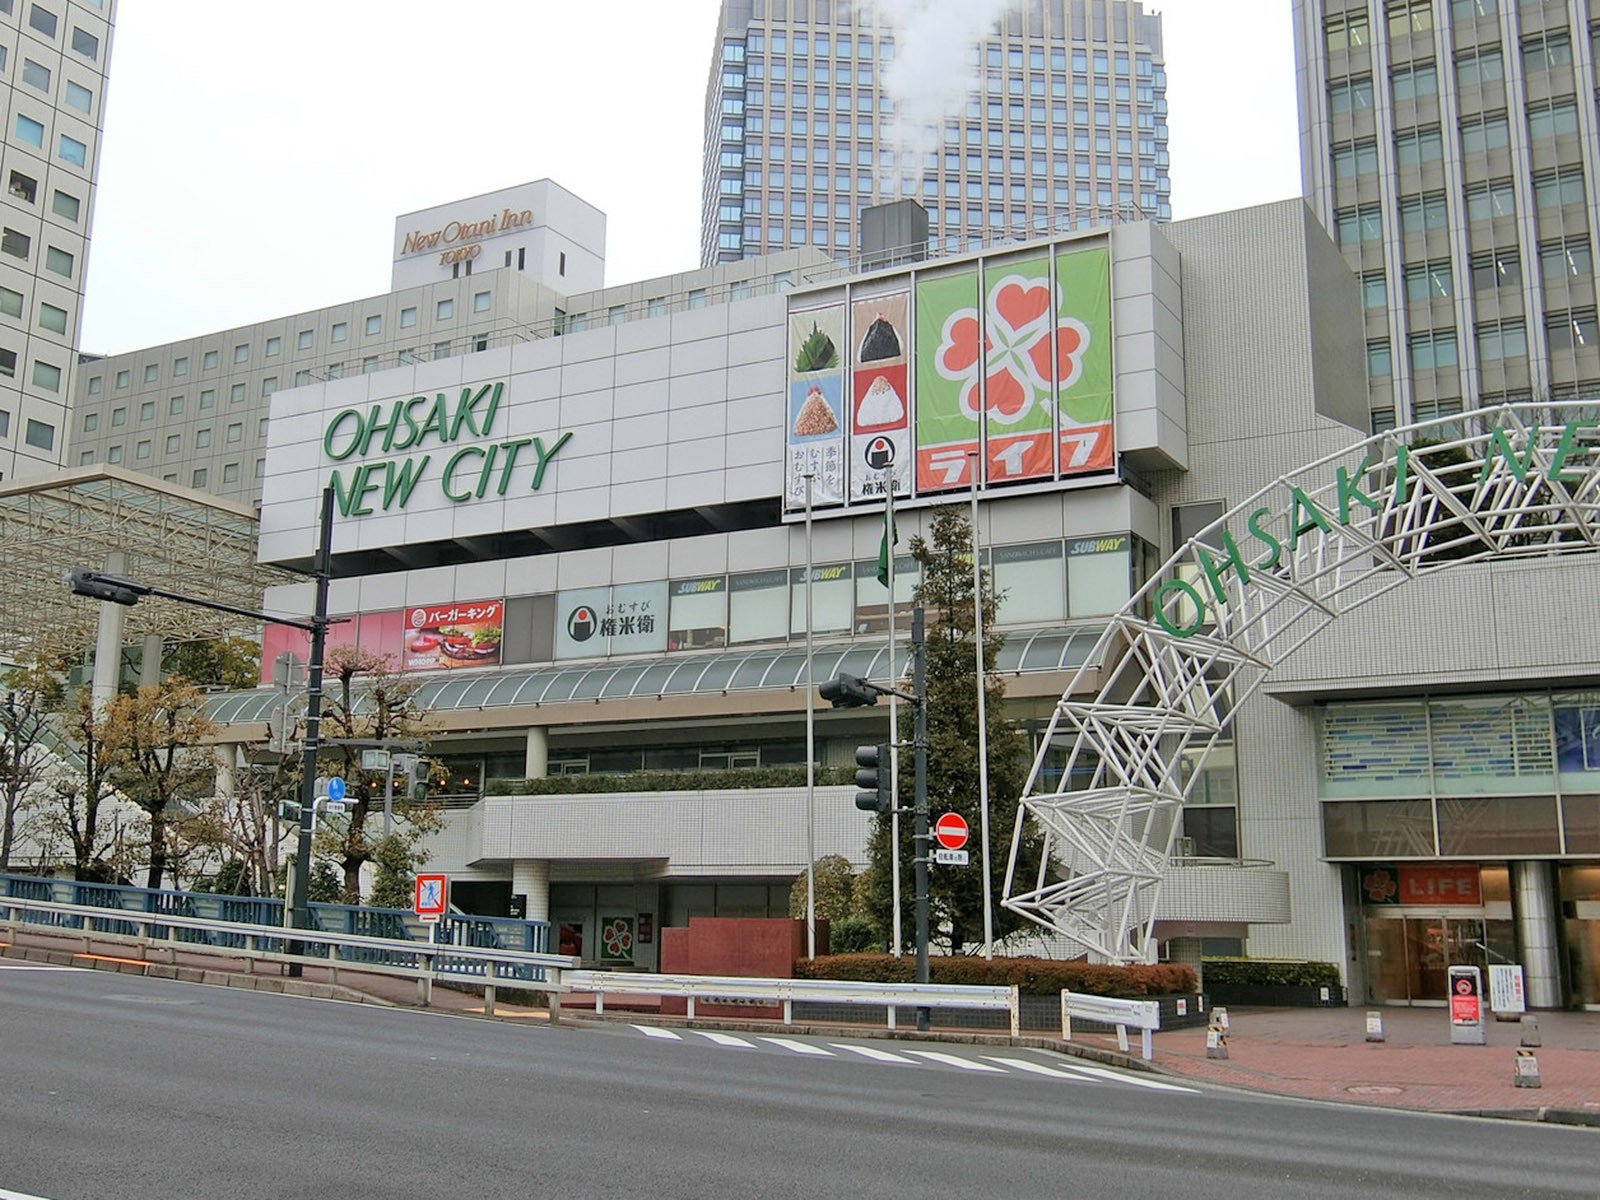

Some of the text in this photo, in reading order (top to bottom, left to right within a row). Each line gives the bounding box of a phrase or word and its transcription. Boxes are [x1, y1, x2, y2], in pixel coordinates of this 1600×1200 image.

[400, 208, 532, 255] New Otani Inn
[439, 244, 482, 266] TOKYO
[323, 381, 504, 461] OHSAKI
[794, 449, 805, 496] おむすび
[825, 445, 837, 485] 季節を
[929, 431, 1099, 484] ライフ
[319, 432, 573, 518] NEW CITY
[1070, 537, 1126, 554] SUBWAY
[1152, 444, 1410, 638] OHSAKI
[678, 579, 721, 594] SUBWAY
[428, 605, 496, 623] バーガーキング
[605, 599, 652, 615] おむすび
[599, 614, 655, 637] 権米衛
[1408, 878, 1473, 895] LIFE
